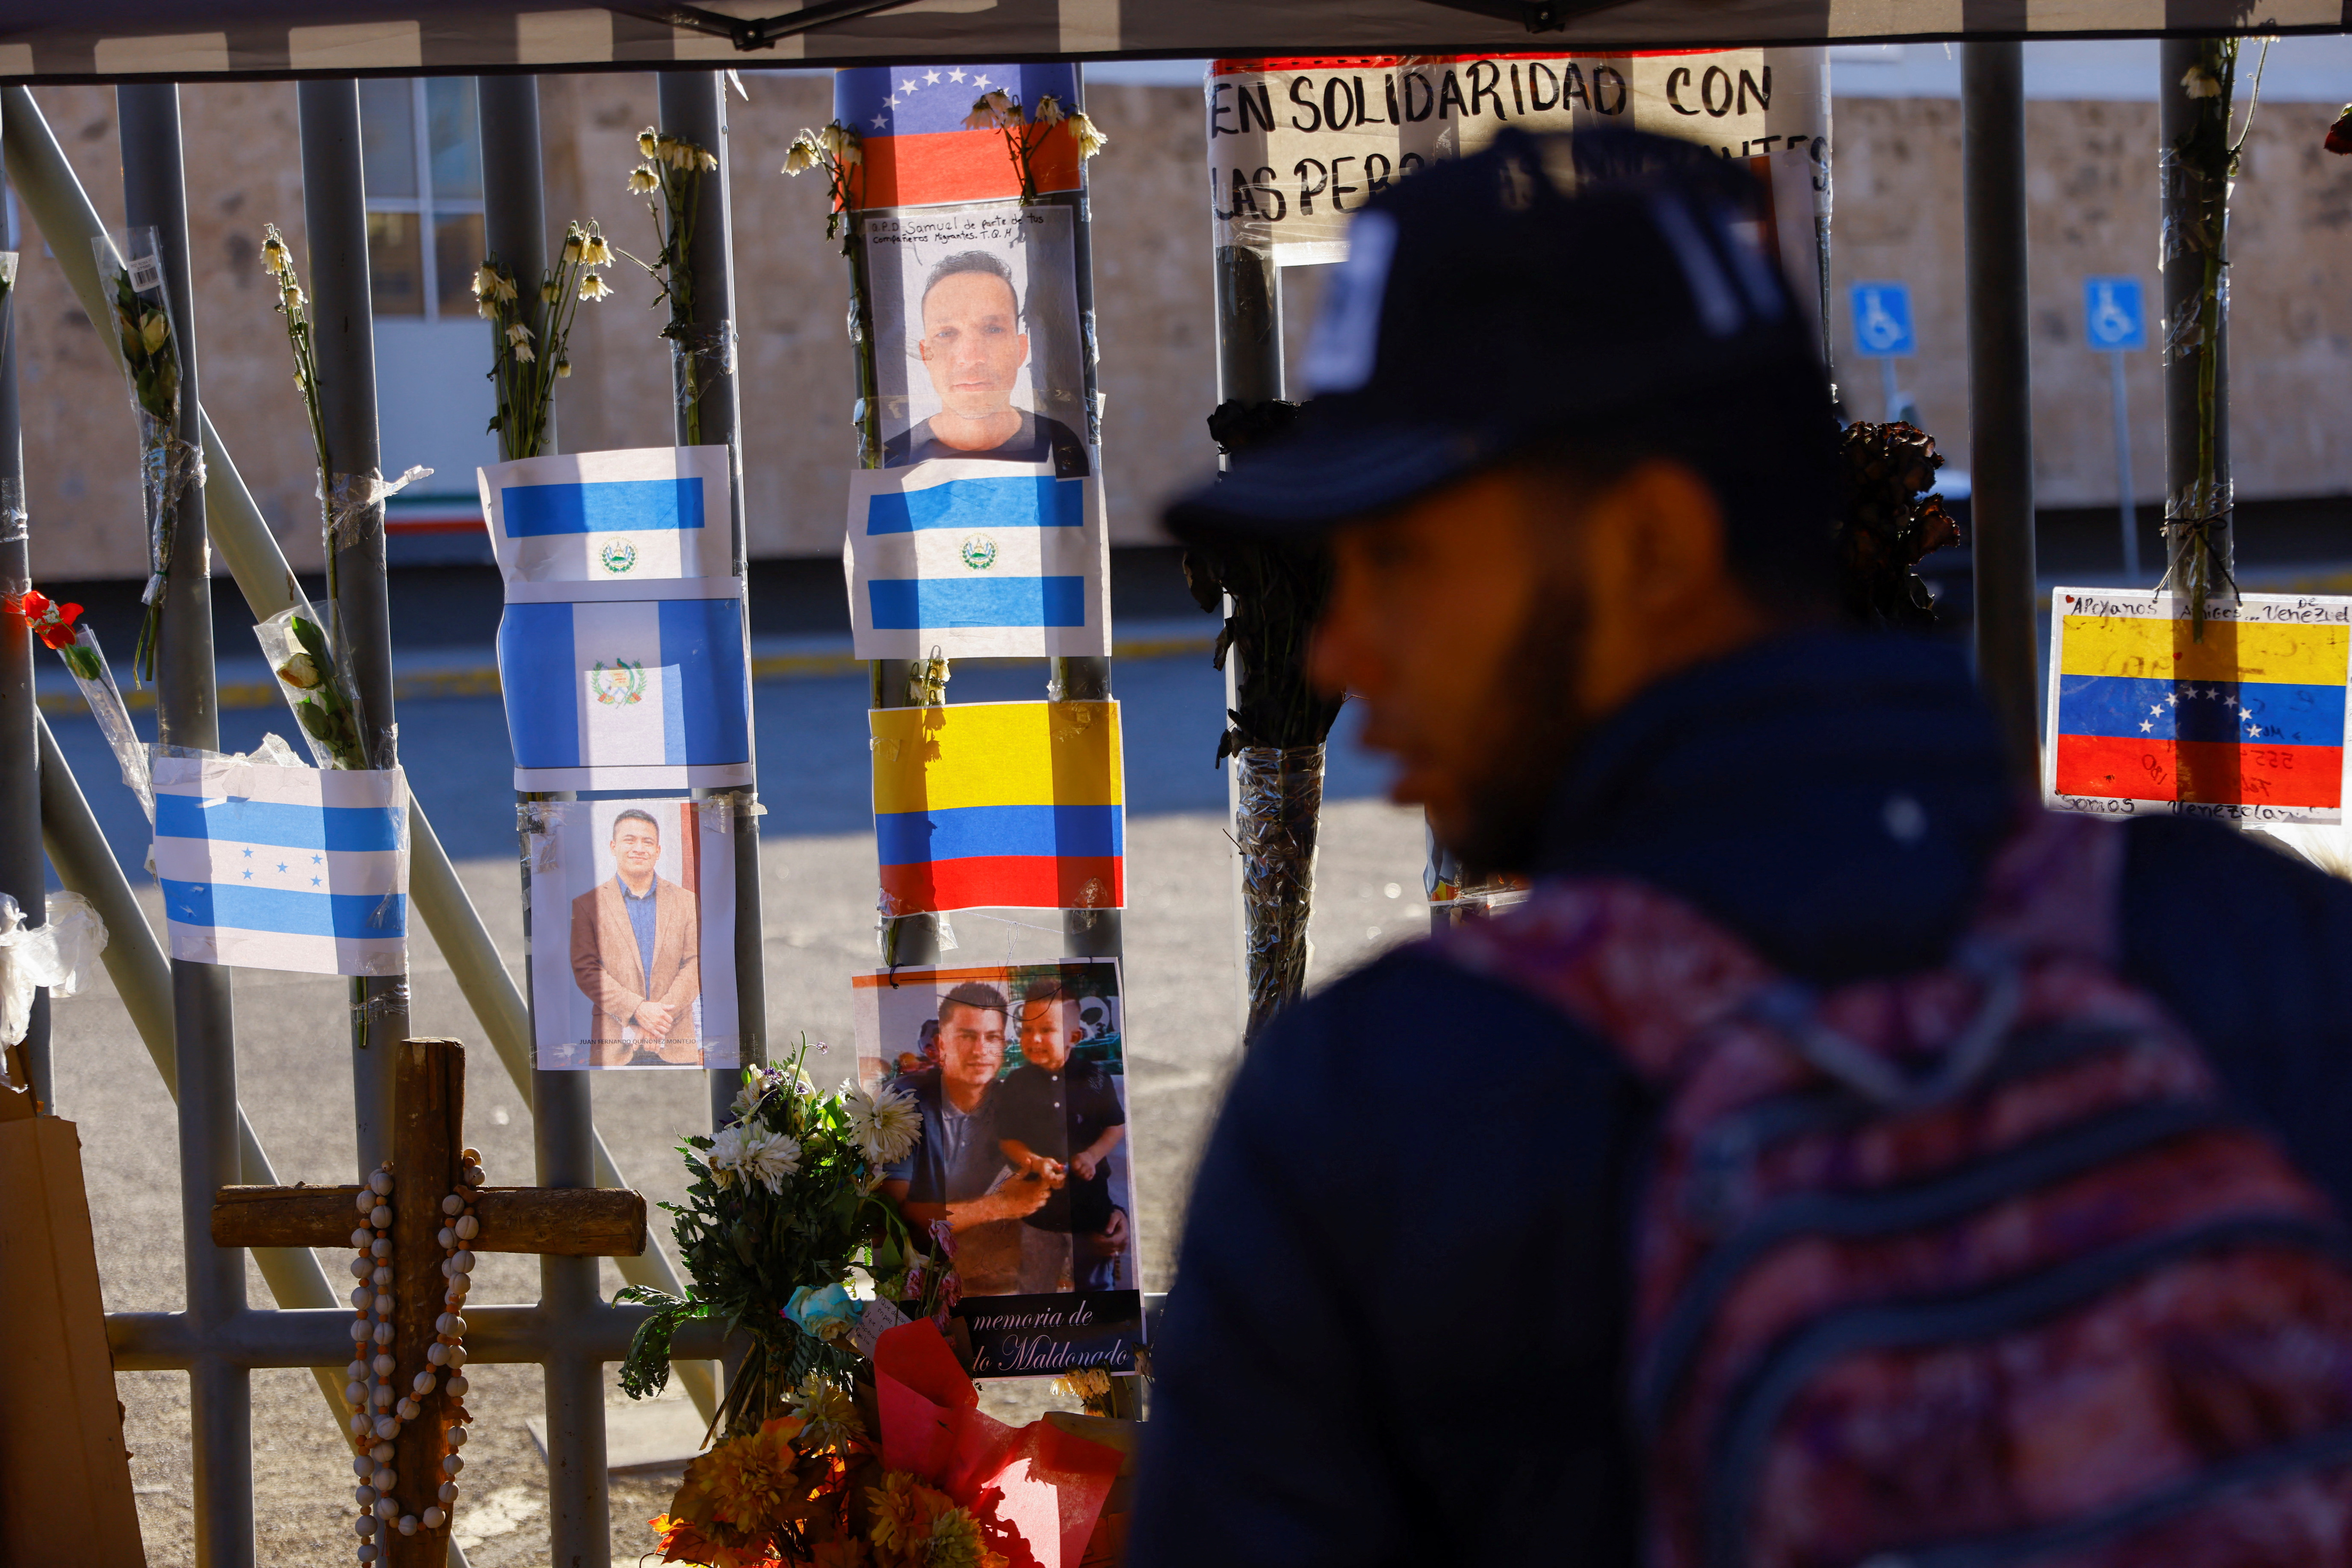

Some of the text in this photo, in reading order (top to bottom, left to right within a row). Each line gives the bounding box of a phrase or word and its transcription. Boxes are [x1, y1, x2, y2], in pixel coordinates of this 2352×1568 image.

[1212, 60, 1772, 139] EN SOLIDARIDAD CON
[1212, 166, 1286, 221] LAS
[964, 219, 975, 230] de
[1011, 214, 1022, 224] de
[1027, 213, 1044, 224] tus
[973, 1300, 1093, 1331] memoria de
[998, 1334, 1129, 1371] Maldonado
